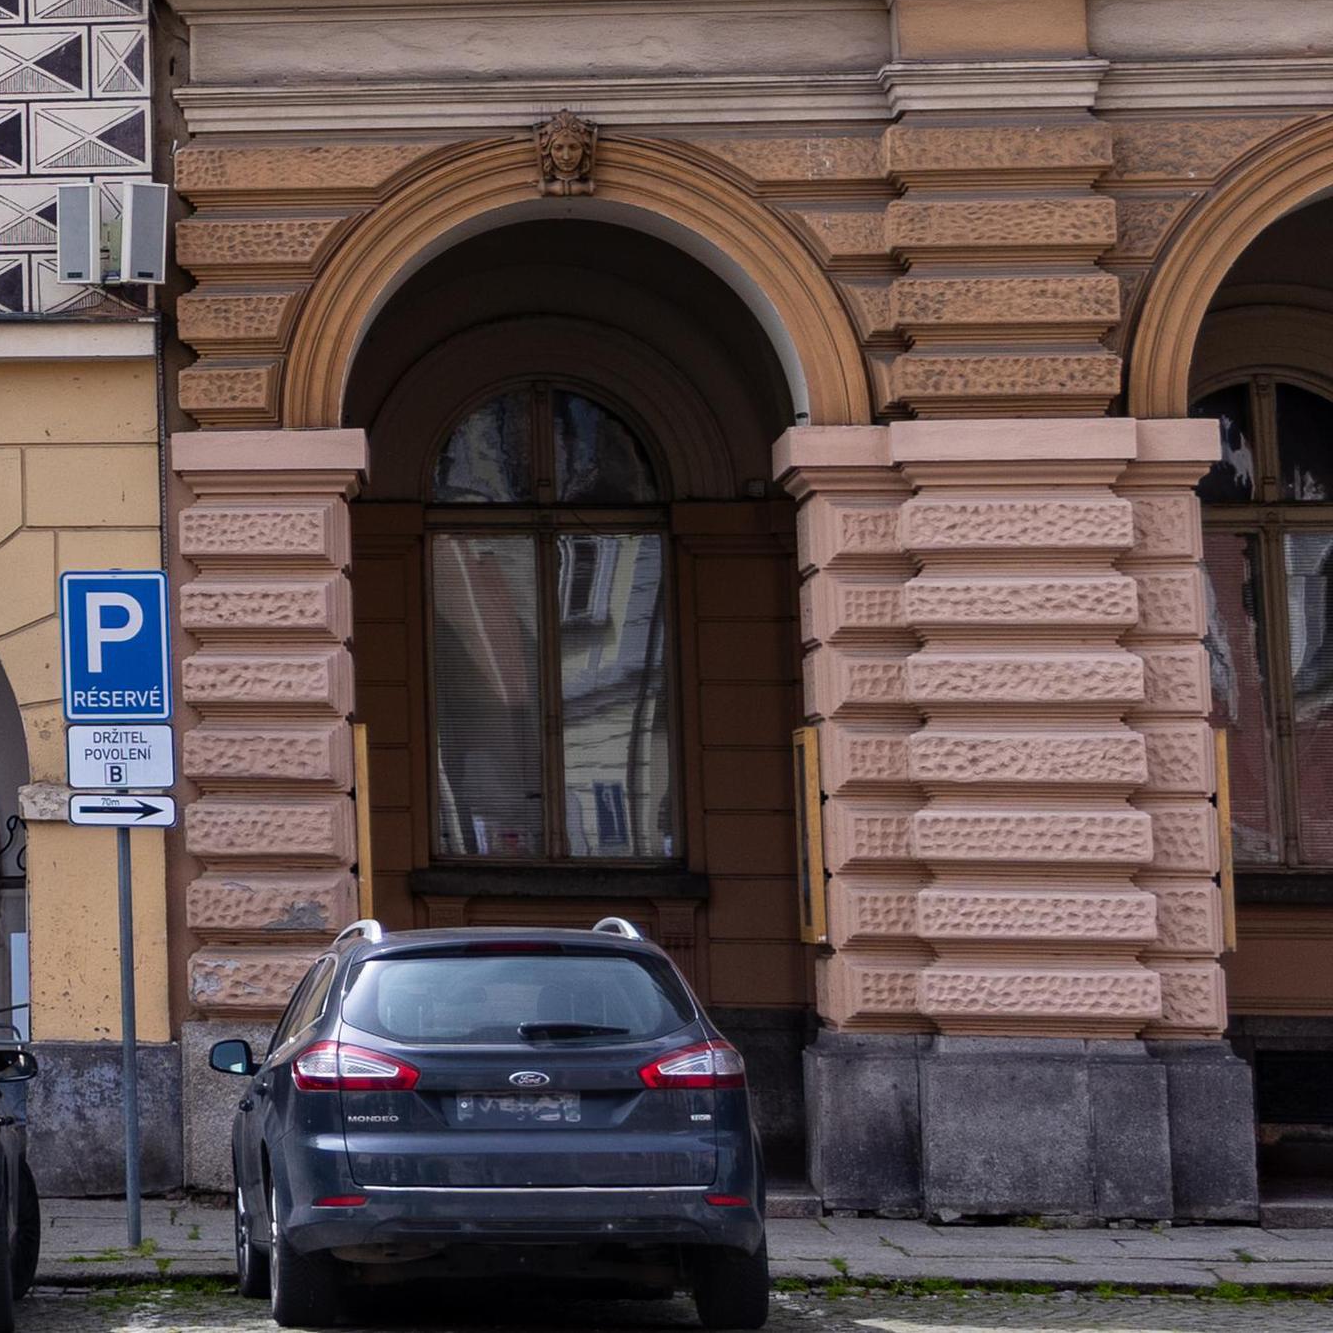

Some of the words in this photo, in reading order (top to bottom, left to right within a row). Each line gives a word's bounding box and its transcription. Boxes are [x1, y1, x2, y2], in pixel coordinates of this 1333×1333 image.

[86, 592, 144, 673] P
[73, 685, 162, 708] RÉSERVÉ
[92, 728, 148, 744] DRŽITEL
[85, 745, 152, 761] POVOLENÍ
[109, 766, 123, 783] B
